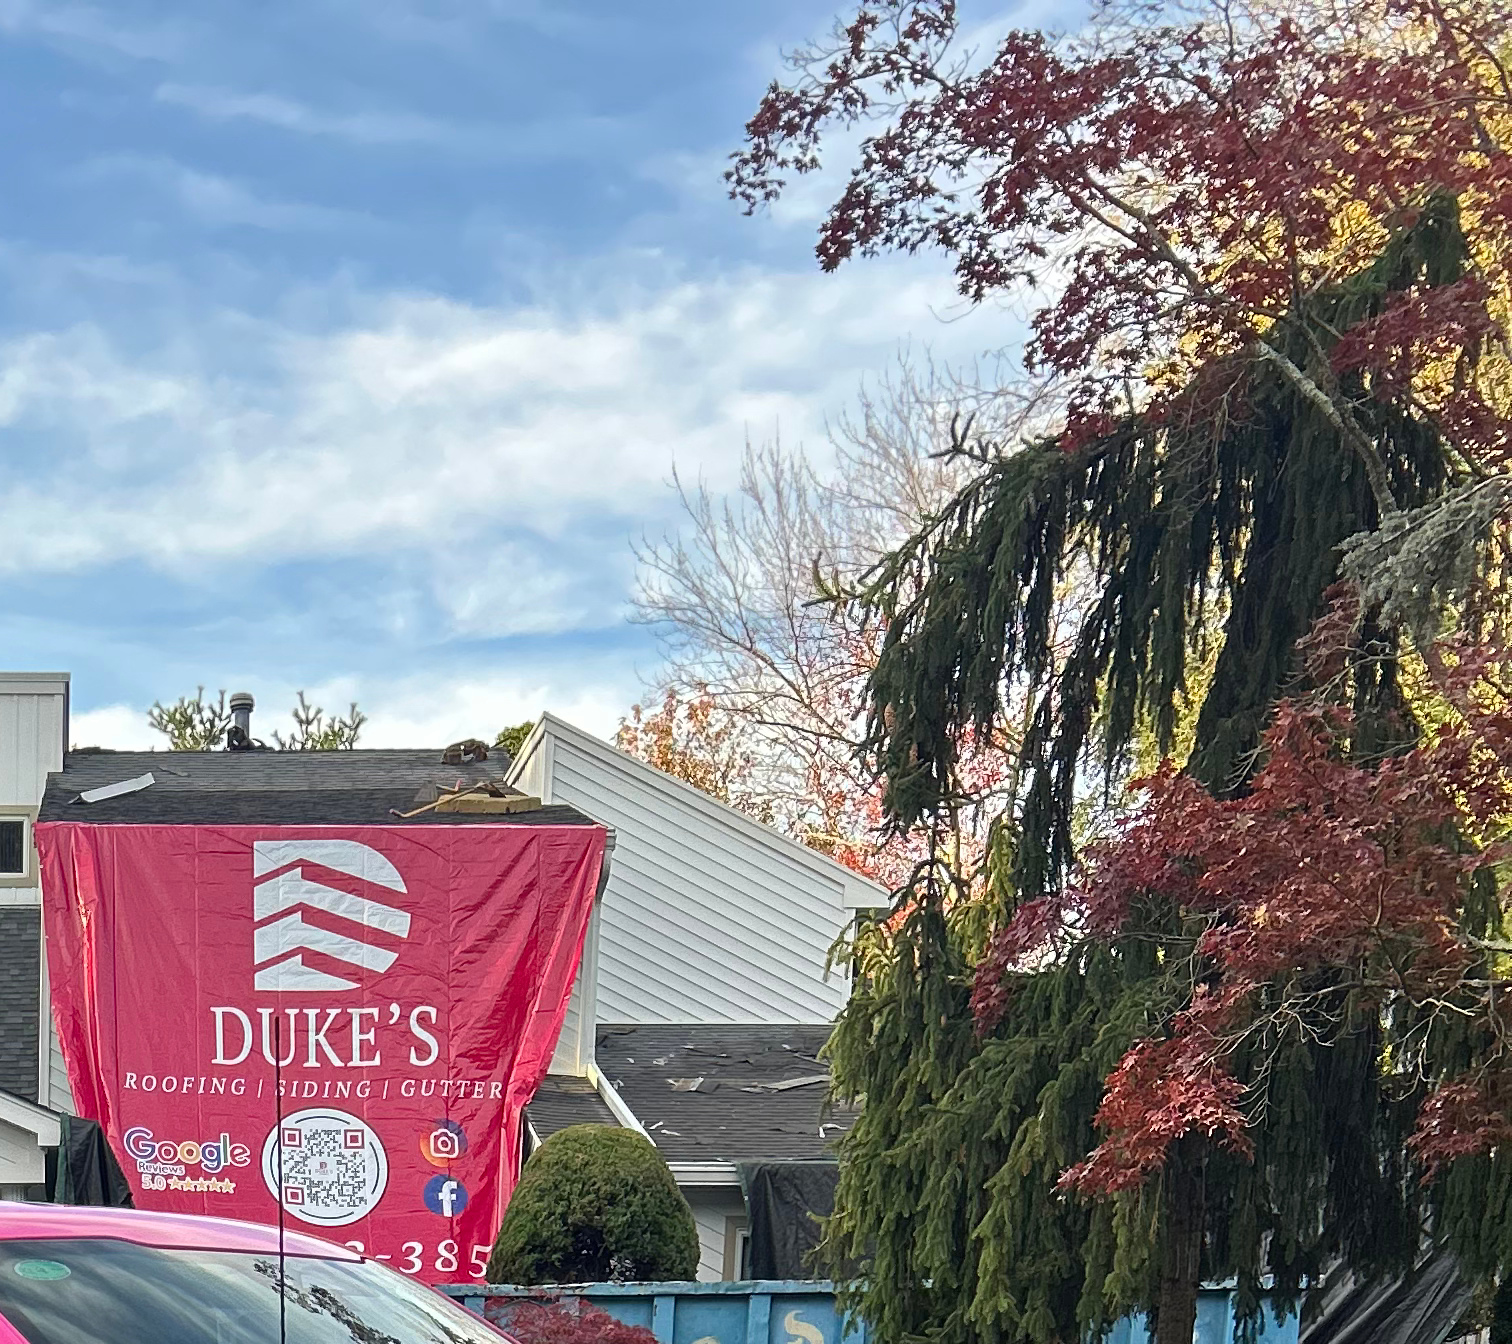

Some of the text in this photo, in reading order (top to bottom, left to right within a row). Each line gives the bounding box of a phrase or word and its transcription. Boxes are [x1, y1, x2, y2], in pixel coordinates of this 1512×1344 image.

[211, 1003, 440, 1067] DUKE'S
[124, 1072, 246, 1096] ROOFING
[275, 1079, 372, 1098] SIDING
[124, 1127, 251, 1173] Google
[136, 1159, 186, 1176] Reviews
